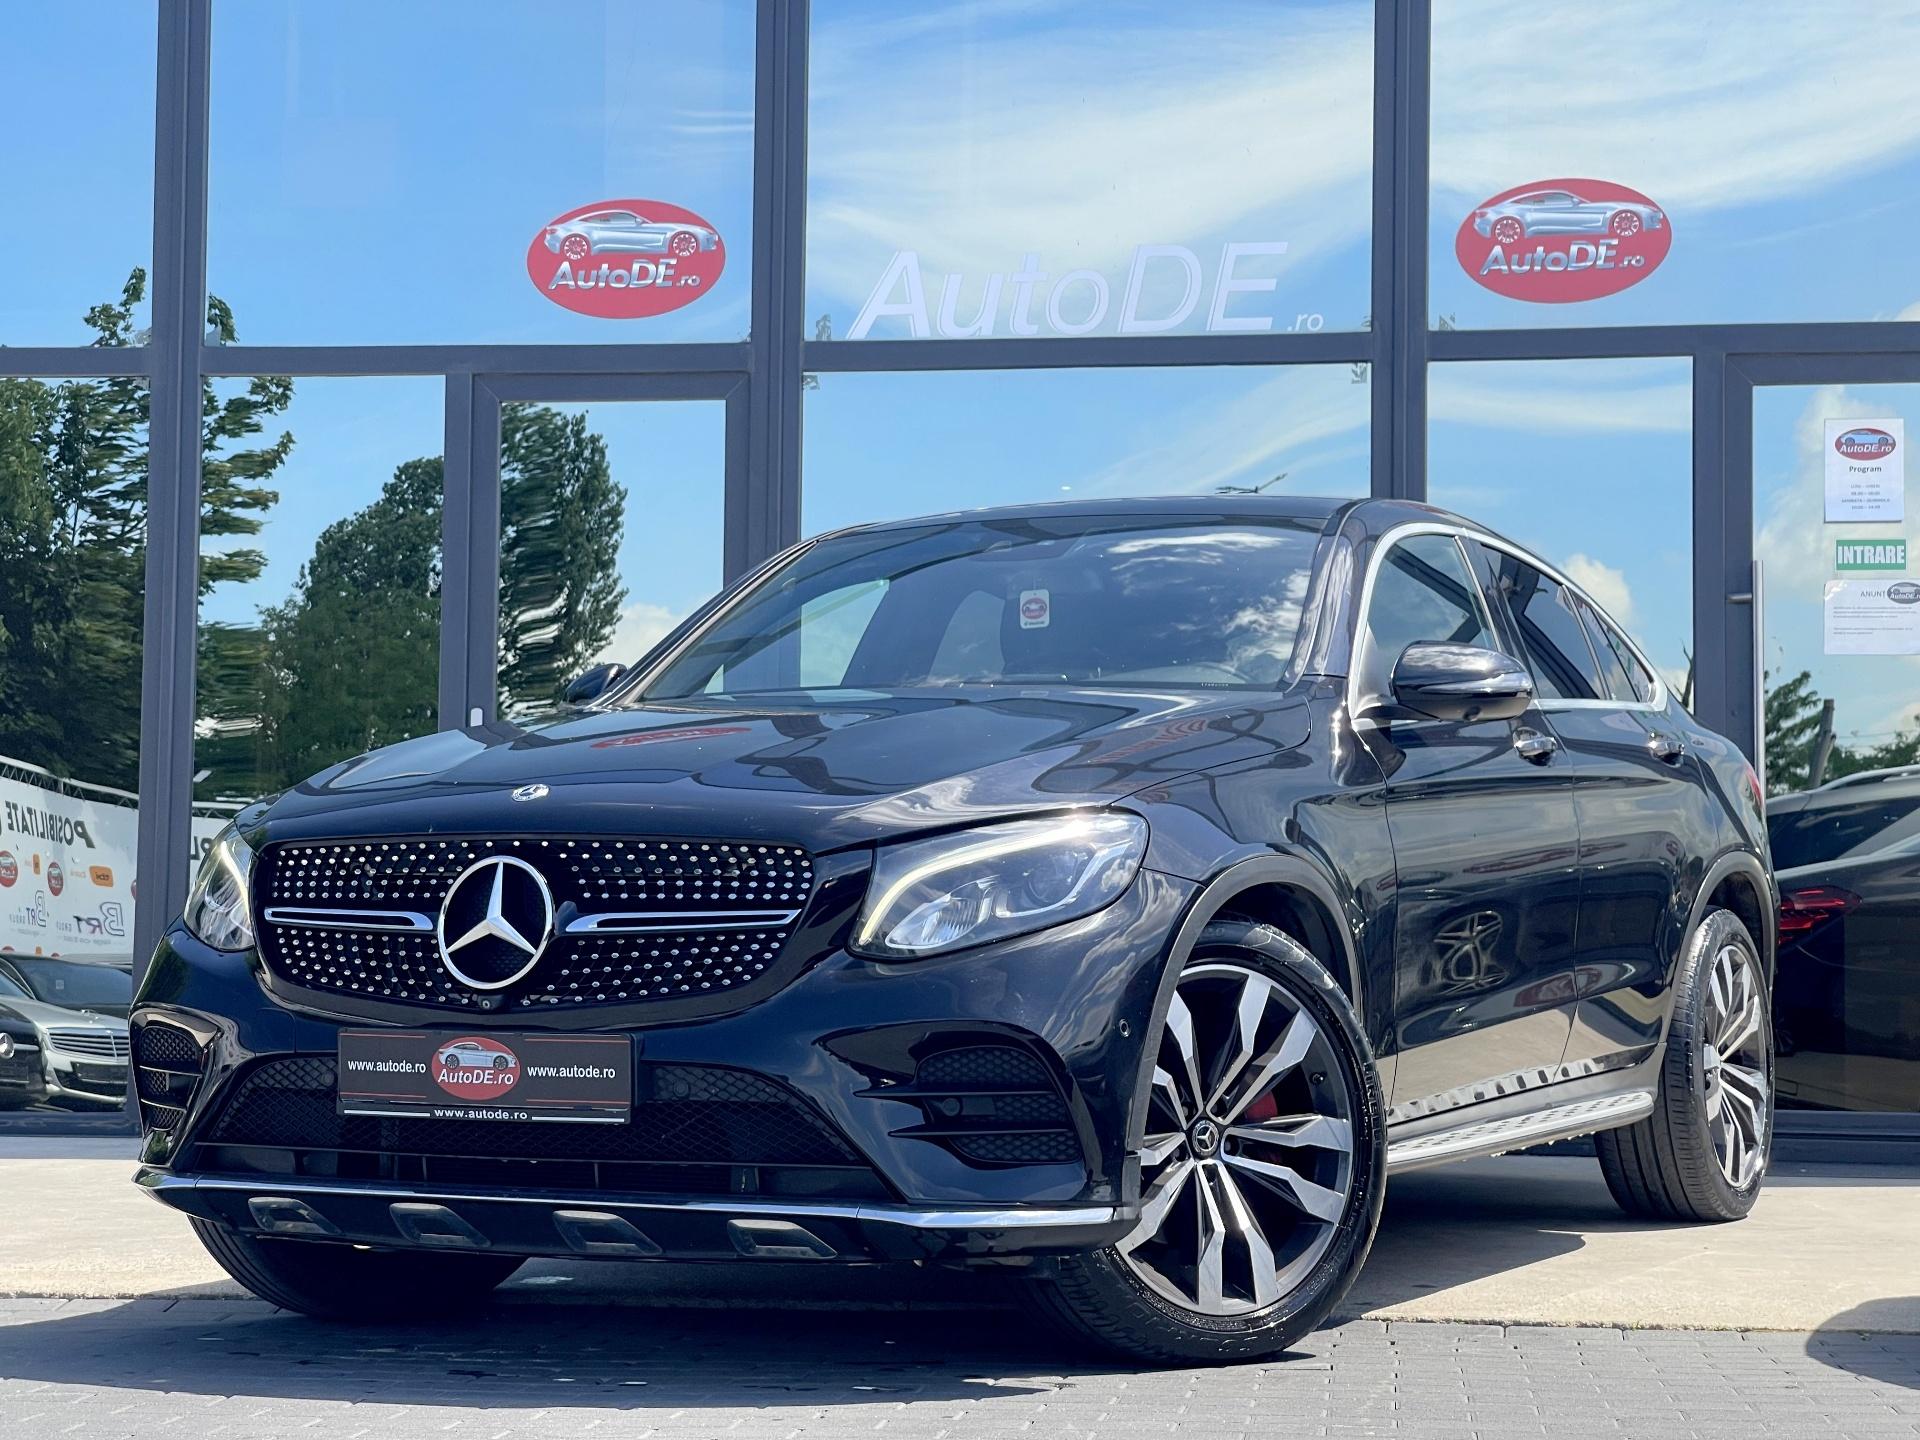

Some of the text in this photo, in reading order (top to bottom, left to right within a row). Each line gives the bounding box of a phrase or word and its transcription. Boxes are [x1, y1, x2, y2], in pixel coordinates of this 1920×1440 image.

[1840, 444, 1892, 453] AutoDE.ro
[1837, 545, 1905, 565] INTRARE
[348, 1059, 427, 1074] www.autode.ro
[527, 1065, 616, 1079] www.autode.ro
[438, 1068, 514, 1086] AutoDE.ro
[434, 1107, 528, 1120] www.autode.ro
